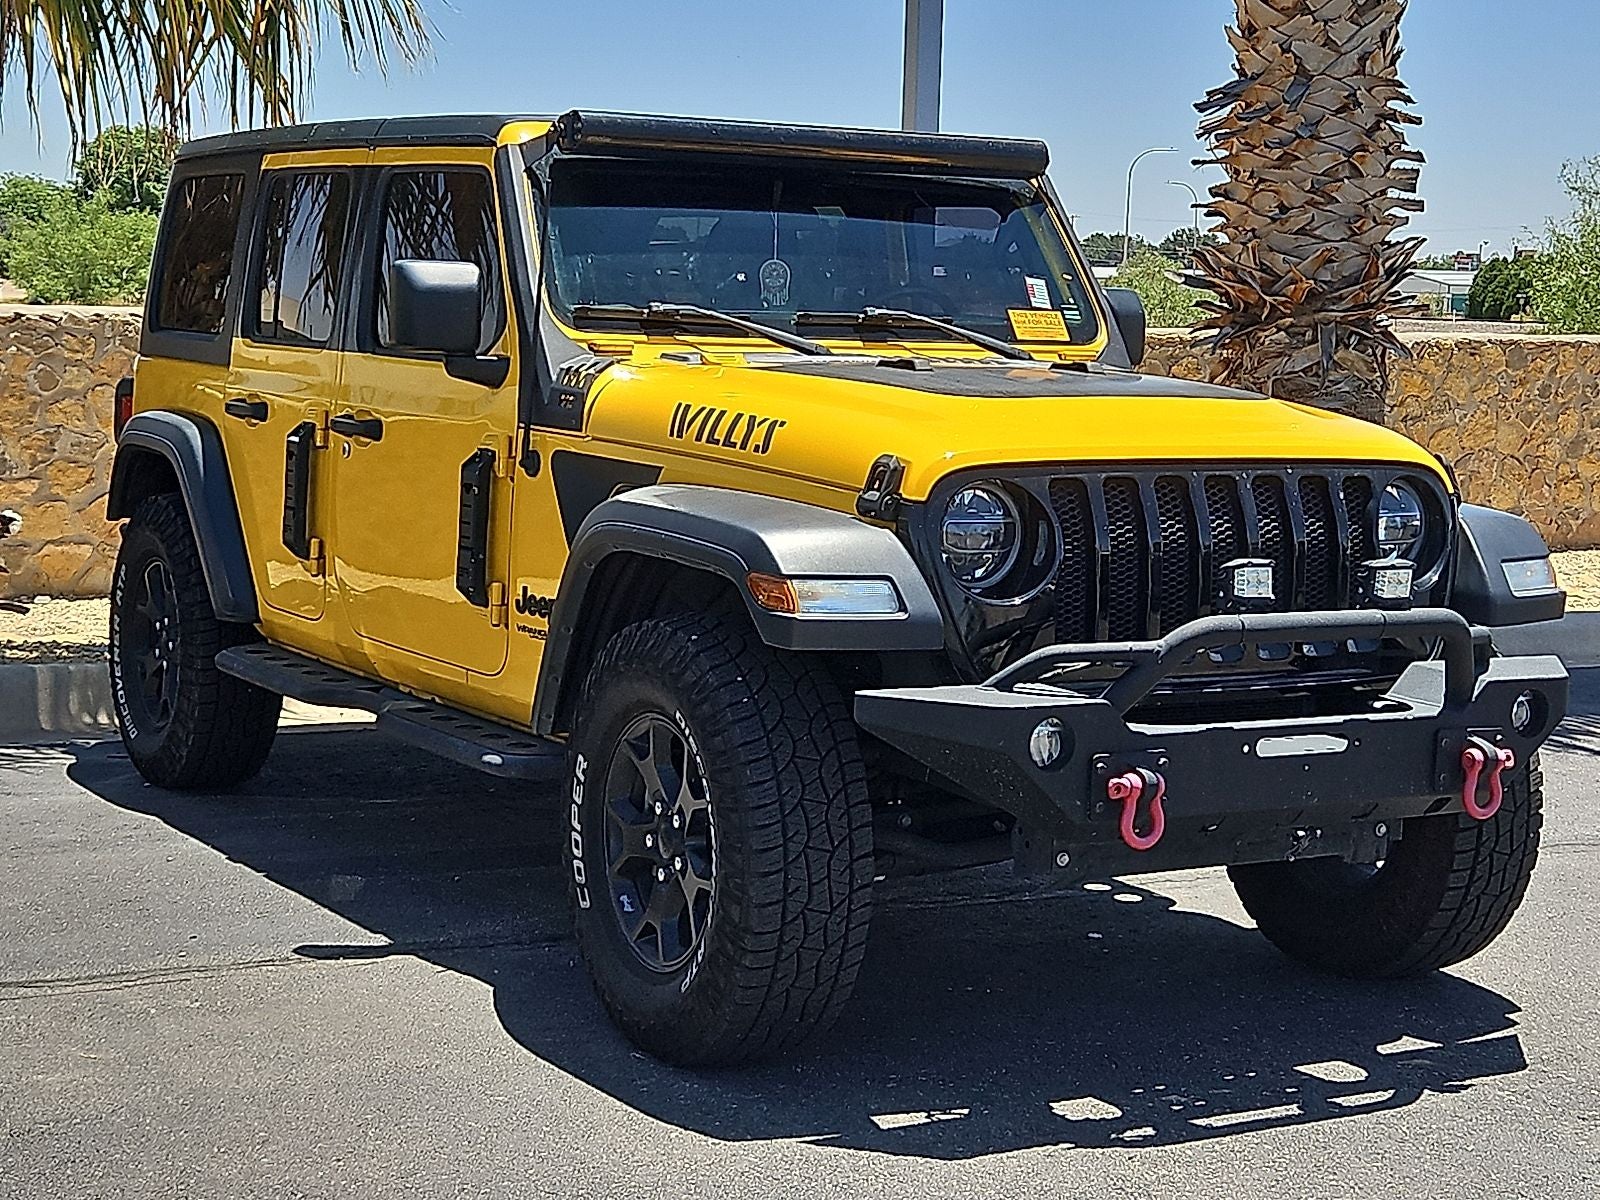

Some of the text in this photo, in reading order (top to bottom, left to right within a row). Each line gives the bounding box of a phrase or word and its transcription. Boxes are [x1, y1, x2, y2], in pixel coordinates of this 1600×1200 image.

[669, 402, 787, 455] WILLYS
[113, 614, 139, 740] DISCOVERER
[571, 754, 590, 909] COOPER
